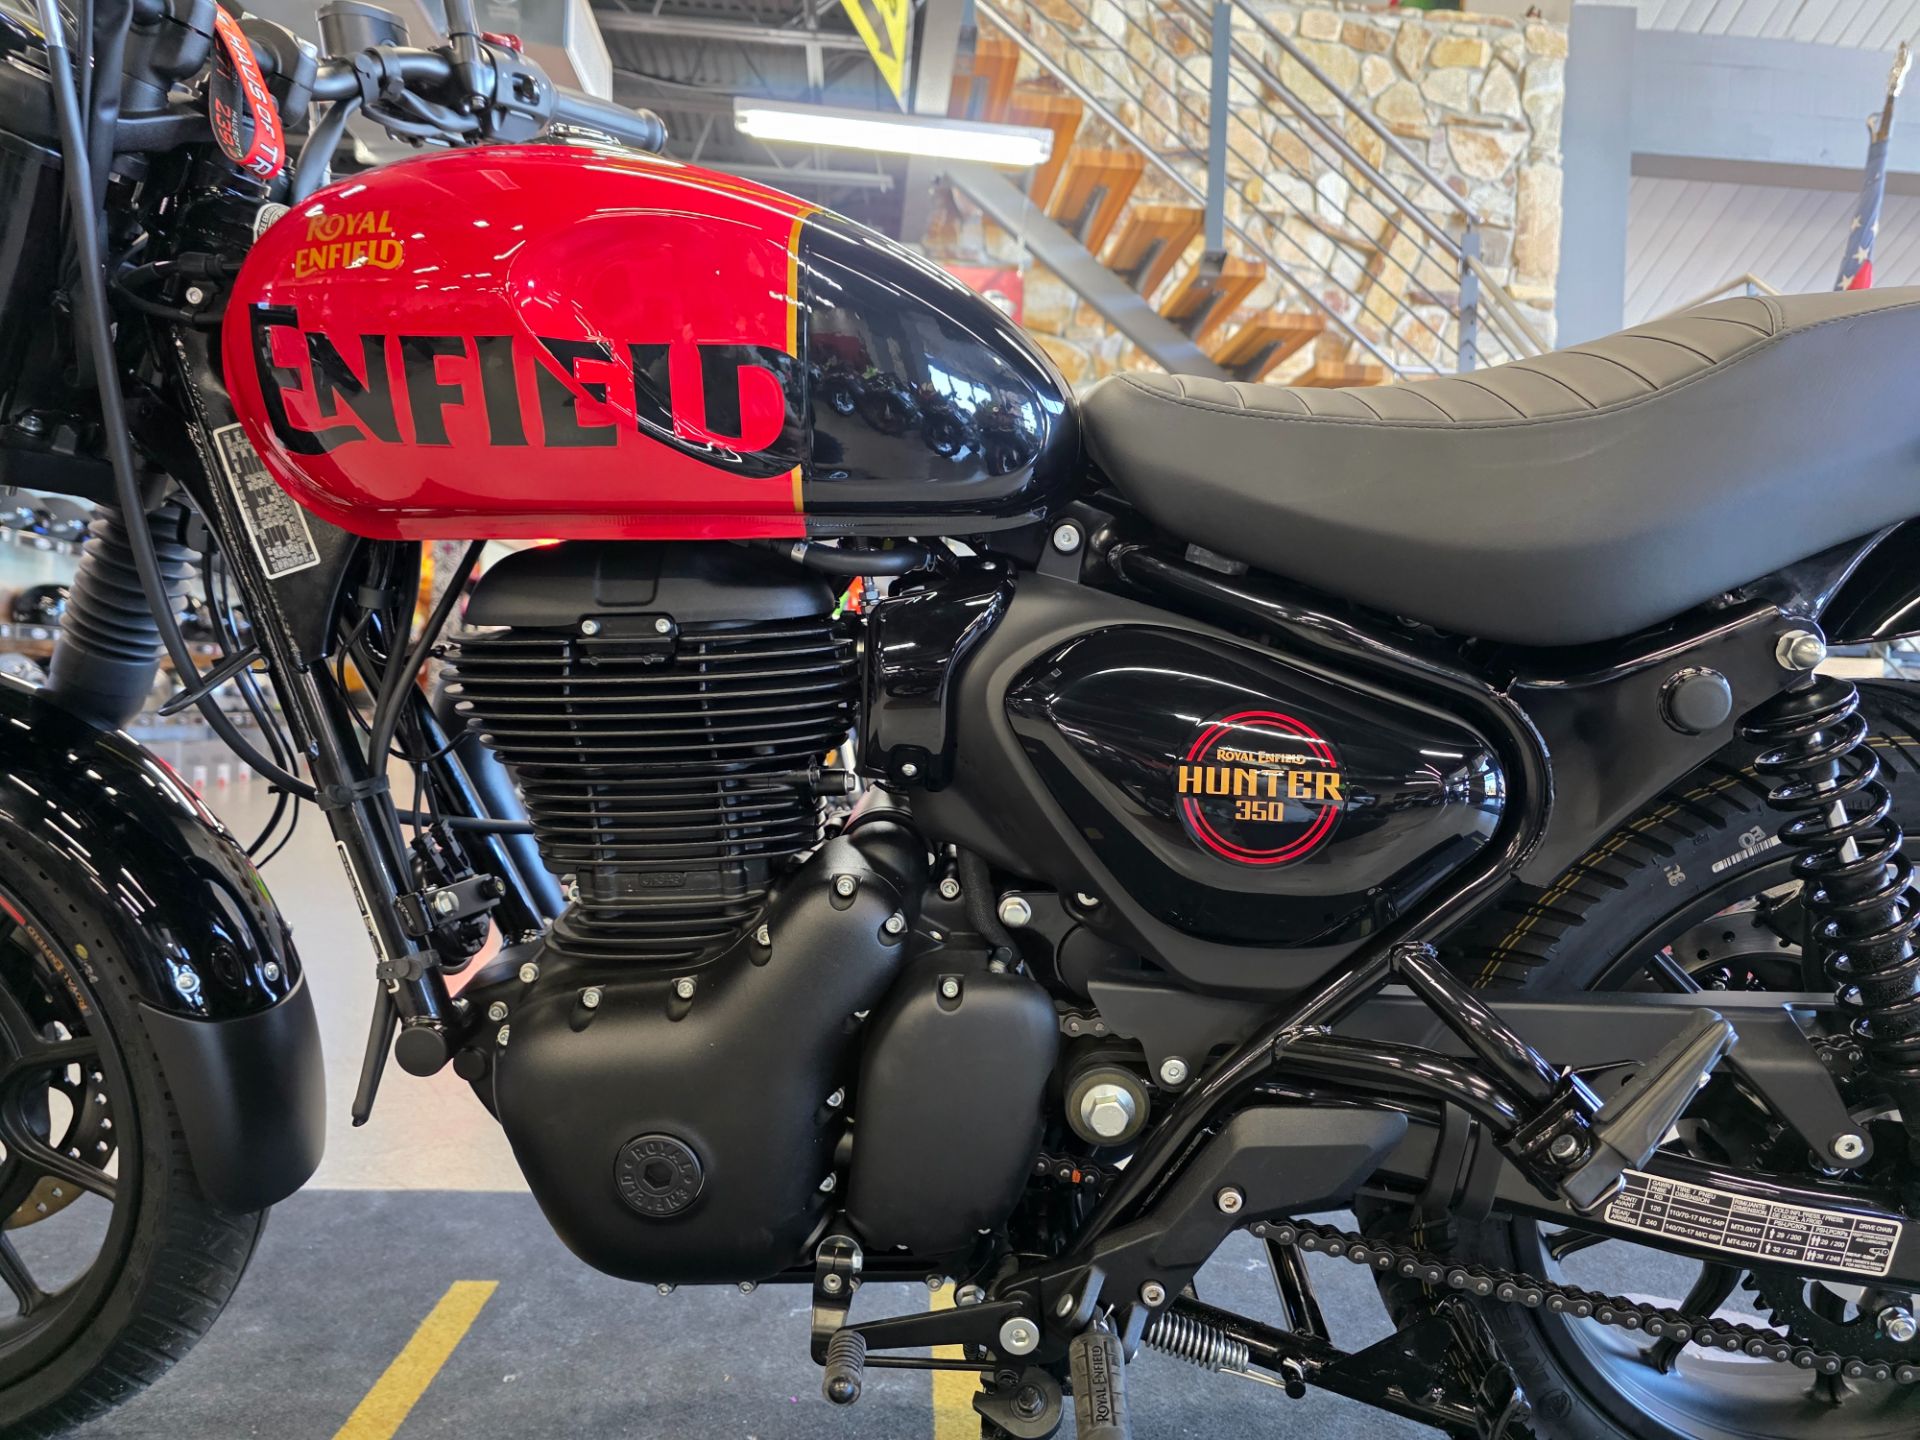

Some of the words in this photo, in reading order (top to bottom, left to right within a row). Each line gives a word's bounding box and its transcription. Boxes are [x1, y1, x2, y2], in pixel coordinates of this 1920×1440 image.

[305, 210, 393, 242] ROYAL
[295, 239, 404, 279] ENFIELD
[248, 302, 801, 479] ENFIELD
[1216, 748, 1255, 763] ROYAL
[1257, 751, 1307, 765] ENFIELD
[1178, 765, 1344, 801] HUNTER
[1235, 800, 1284, 822] 350
[1650, 1204, 1662, 1212] 120
[1091, 1345, 1107, 1385] ENFIELD
[1096, 1387, 1109, 1422] ROYAL
